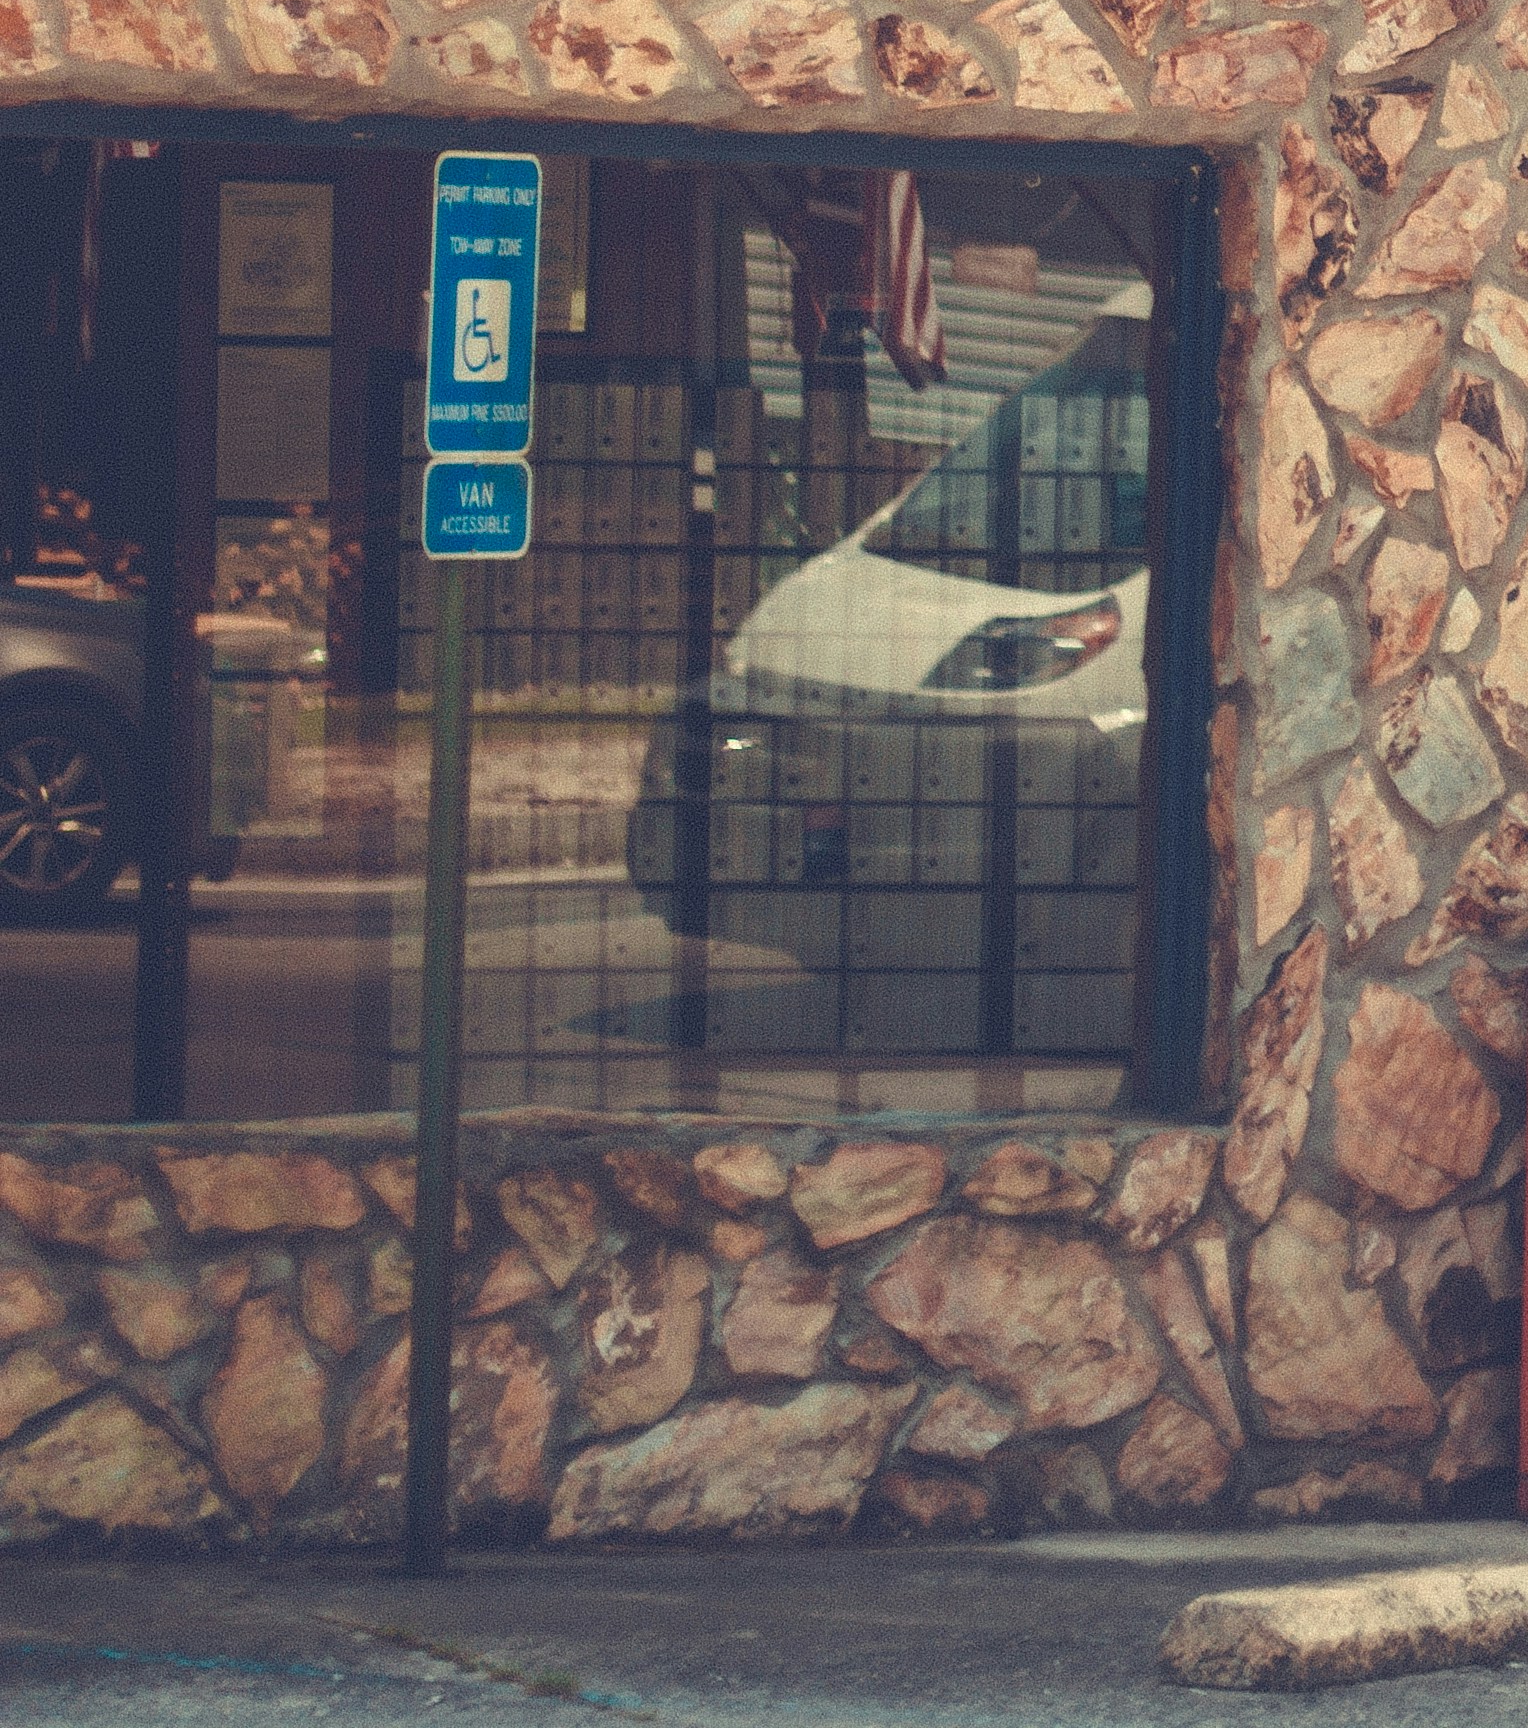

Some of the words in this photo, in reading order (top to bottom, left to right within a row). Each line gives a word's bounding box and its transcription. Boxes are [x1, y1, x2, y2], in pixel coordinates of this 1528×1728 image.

[513, 186, 537, 207] ONLY
[497, 237, 523, 257] ZONE
[459, 481, 495, 509] VAN
[440, 515, 511, 534] ACCESSIBLE
